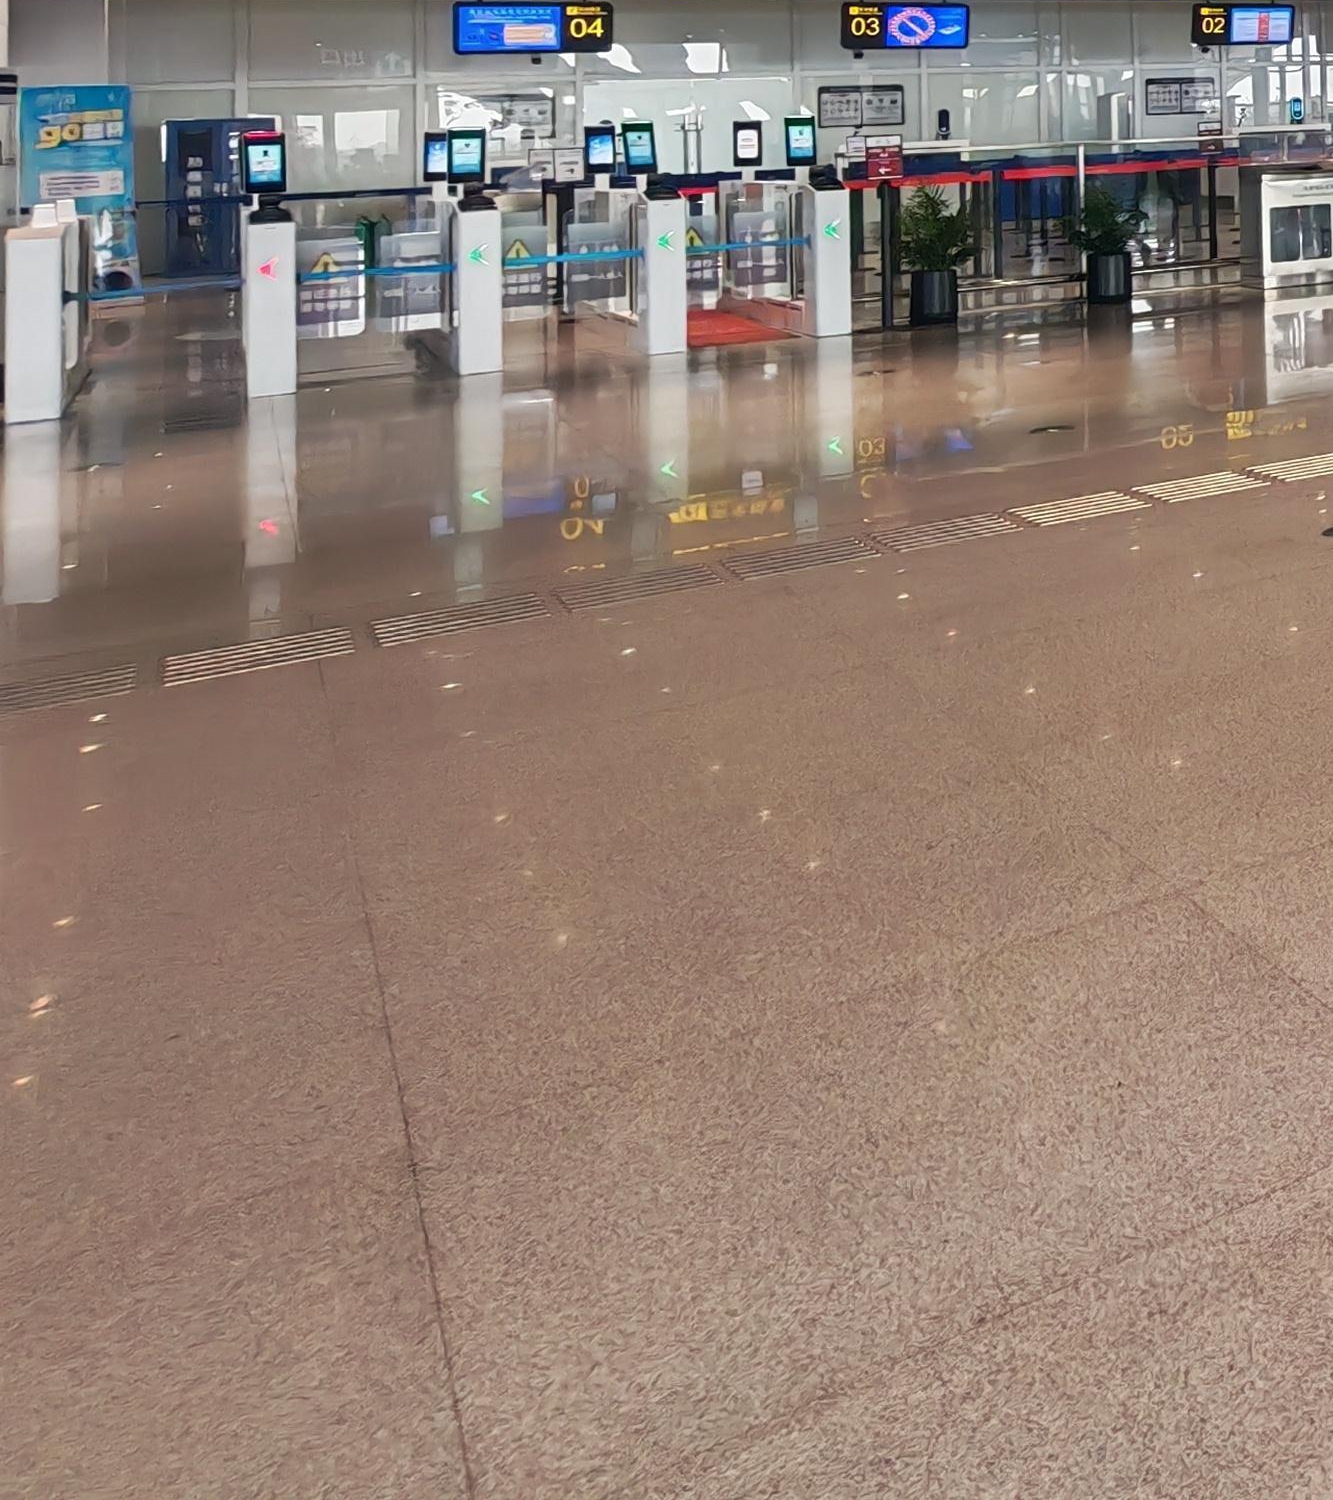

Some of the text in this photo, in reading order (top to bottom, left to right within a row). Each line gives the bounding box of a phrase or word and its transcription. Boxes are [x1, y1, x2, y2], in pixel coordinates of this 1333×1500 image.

[570, 18, 604, 38] 04
[851, 17, 880, 36] 03
[1202, 17, 1225, 33] 02
